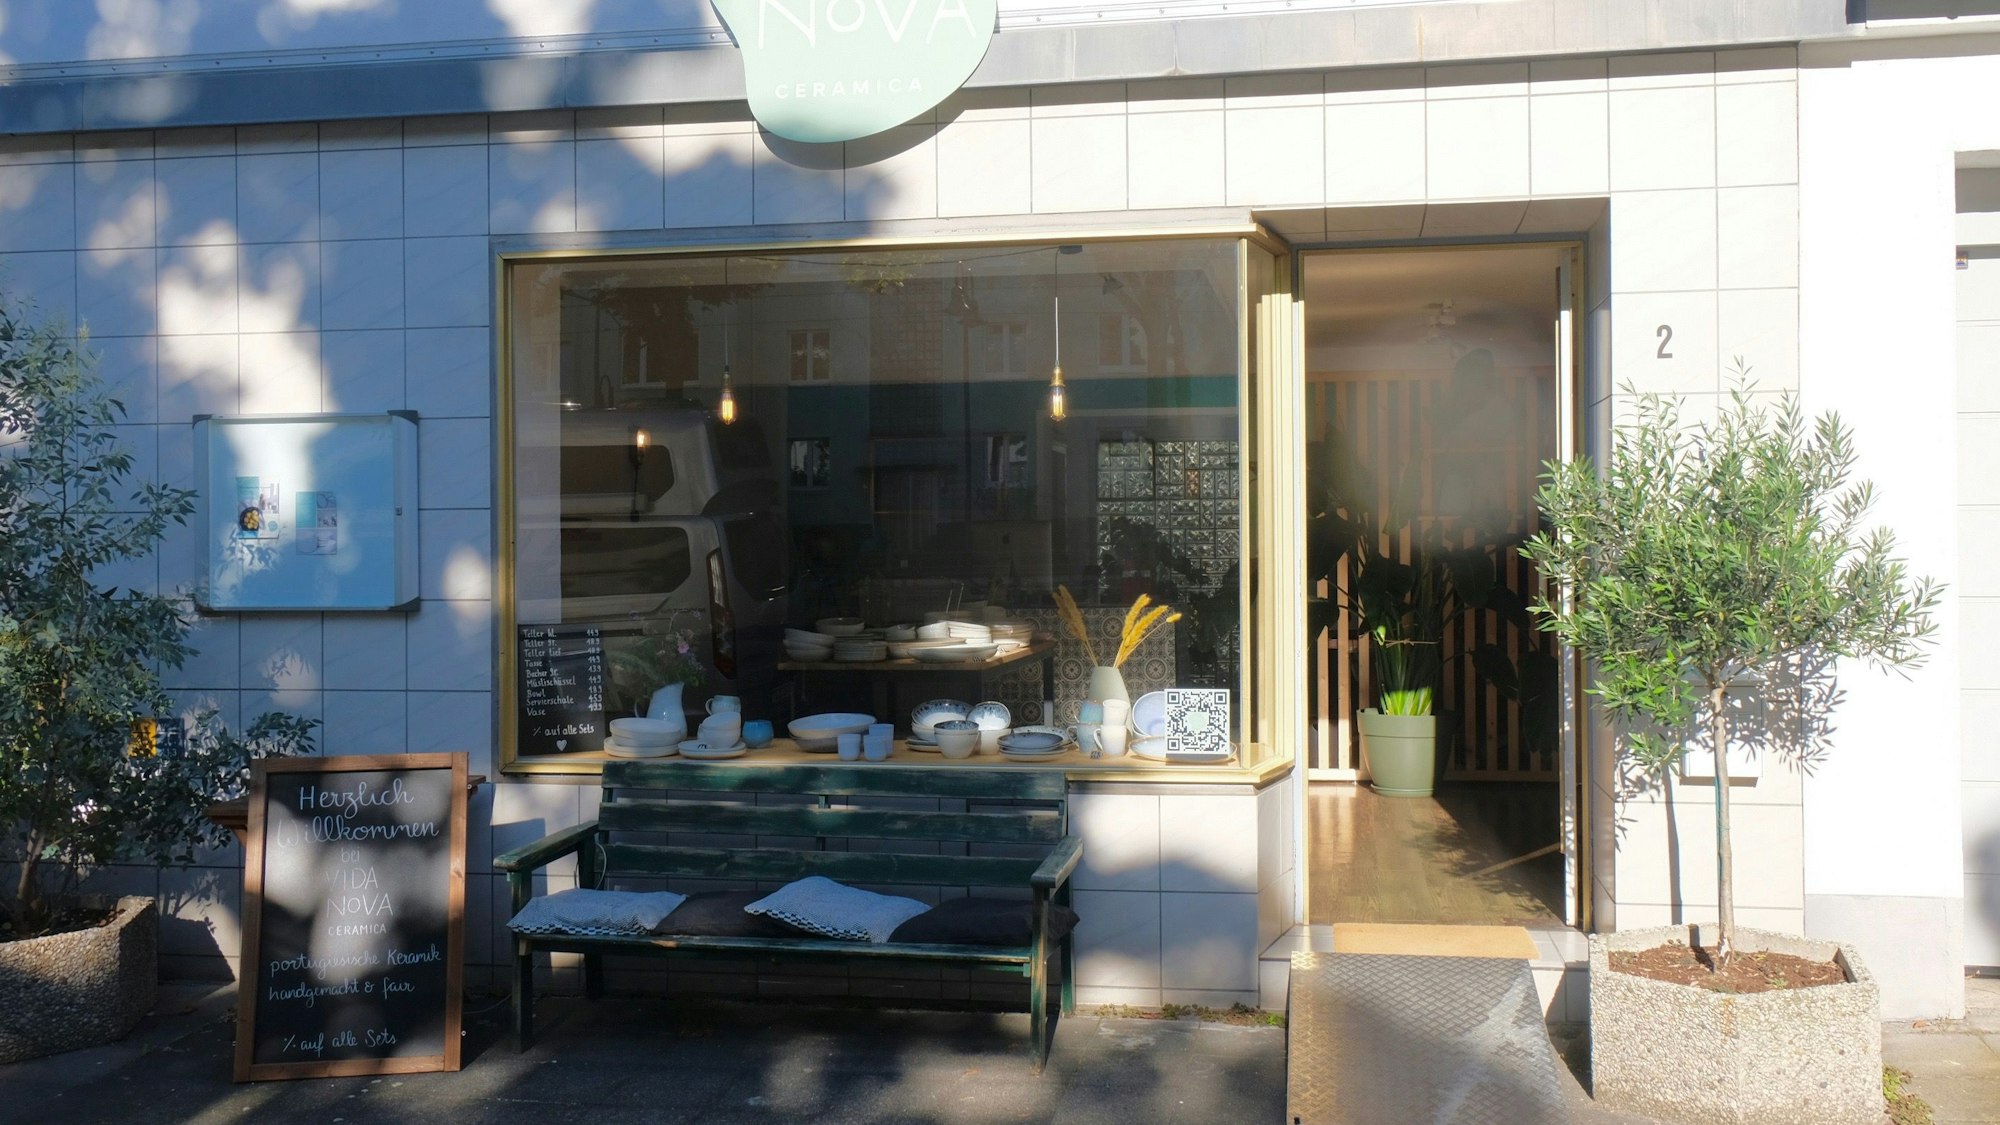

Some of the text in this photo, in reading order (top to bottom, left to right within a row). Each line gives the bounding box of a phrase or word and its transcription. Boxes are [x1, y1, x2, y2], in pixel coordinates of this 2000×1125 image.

[775, 77, 923, 99] CERAMICA
[1656, 324, 1673, 359] 2
[526, 688, 546, 698] Bowl
[526, 707, 546, 716] Vase
[544, 725, 560, 736] auf
[562, 724, 577, 736] alle
[300, 778, 414, 819] Herzlich
[277, 814, 439, 848] Willkommen
[341, 847, 360, 863] bei
[325, 866, 379, 892] VIDA
[326, 893, 394, 918] NOVA
[328, 923, 387, 936] CERAMICA
[269, 944, 442, 980] portugiesische Keramik
[269, 977, 359, 1008] handgemacht
[383, 976, 415, 999] fair
[300, 1032, 324, 1058] auf
[332, 1030, 358, 1048] alle
[364, 1027, 396, 1048] Sets
